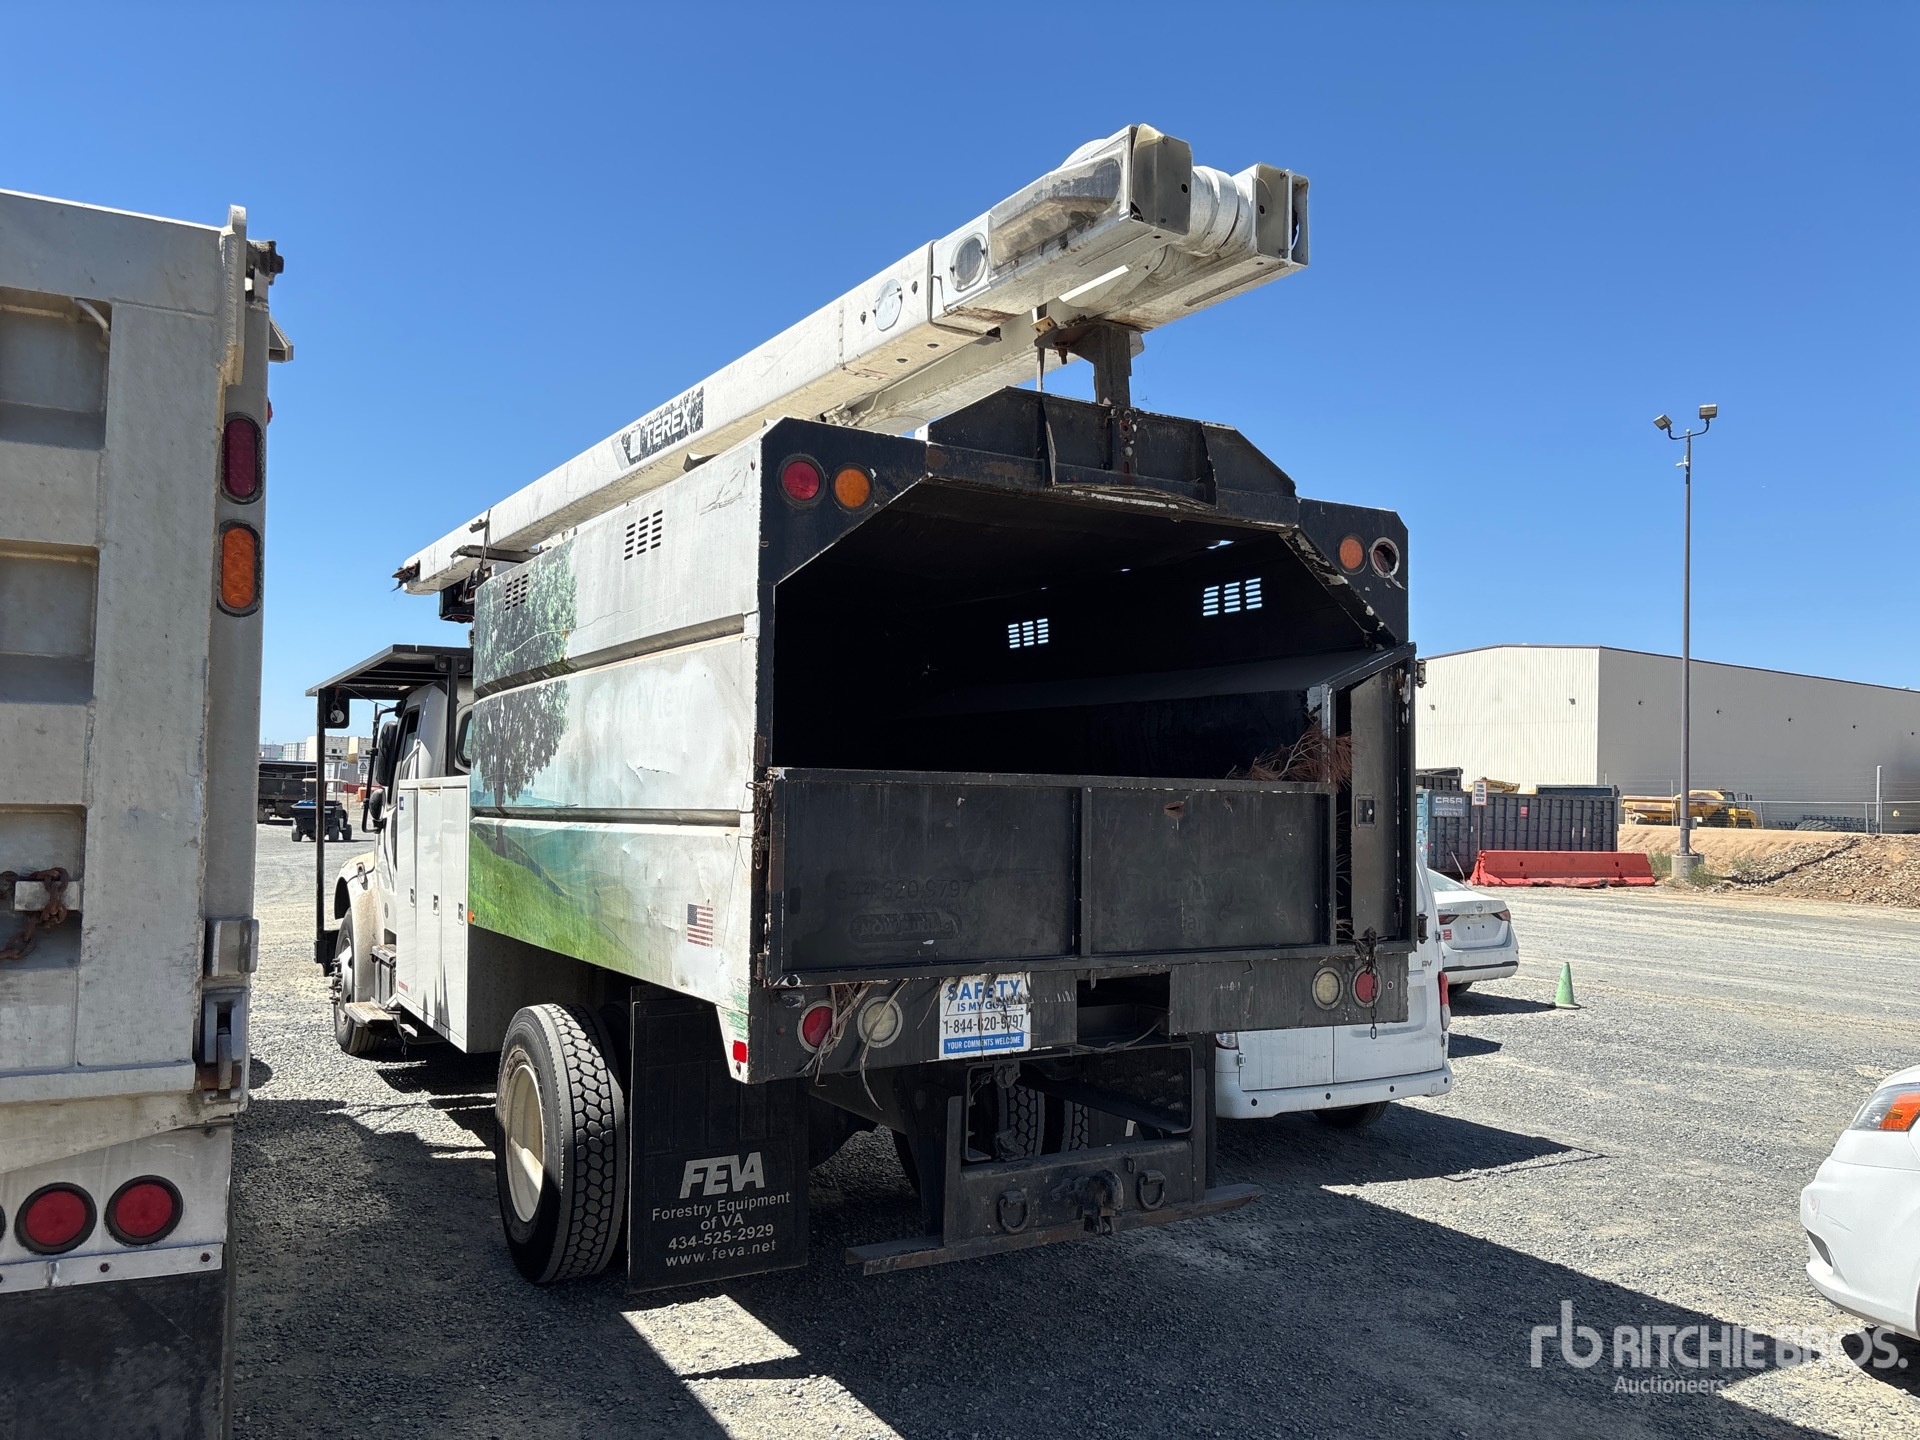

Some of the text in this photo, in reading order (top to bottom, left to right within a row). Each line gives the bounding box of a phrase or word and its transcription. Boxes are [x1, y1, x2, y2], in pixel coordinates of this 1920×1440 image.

[645, 404, 692, 449] TEREX
[947, 980, 1021, 1002] SAFETY
[957, 1003, 966, 1012] IS
[968, 1002, 984, 1011] MY
[947, 1035, 1021, 1050] YOUR COMMNTS WELCOME
[679, 1151, 765, 1199] FEVA
[652, 1191, 790, 1221] Forestry Equipment
[700, 1213, 744, 1231] of VA
[668, 1223, 774, 1250] 434-525-2929
[666, 1239, 777, 1267] www.feva.net
